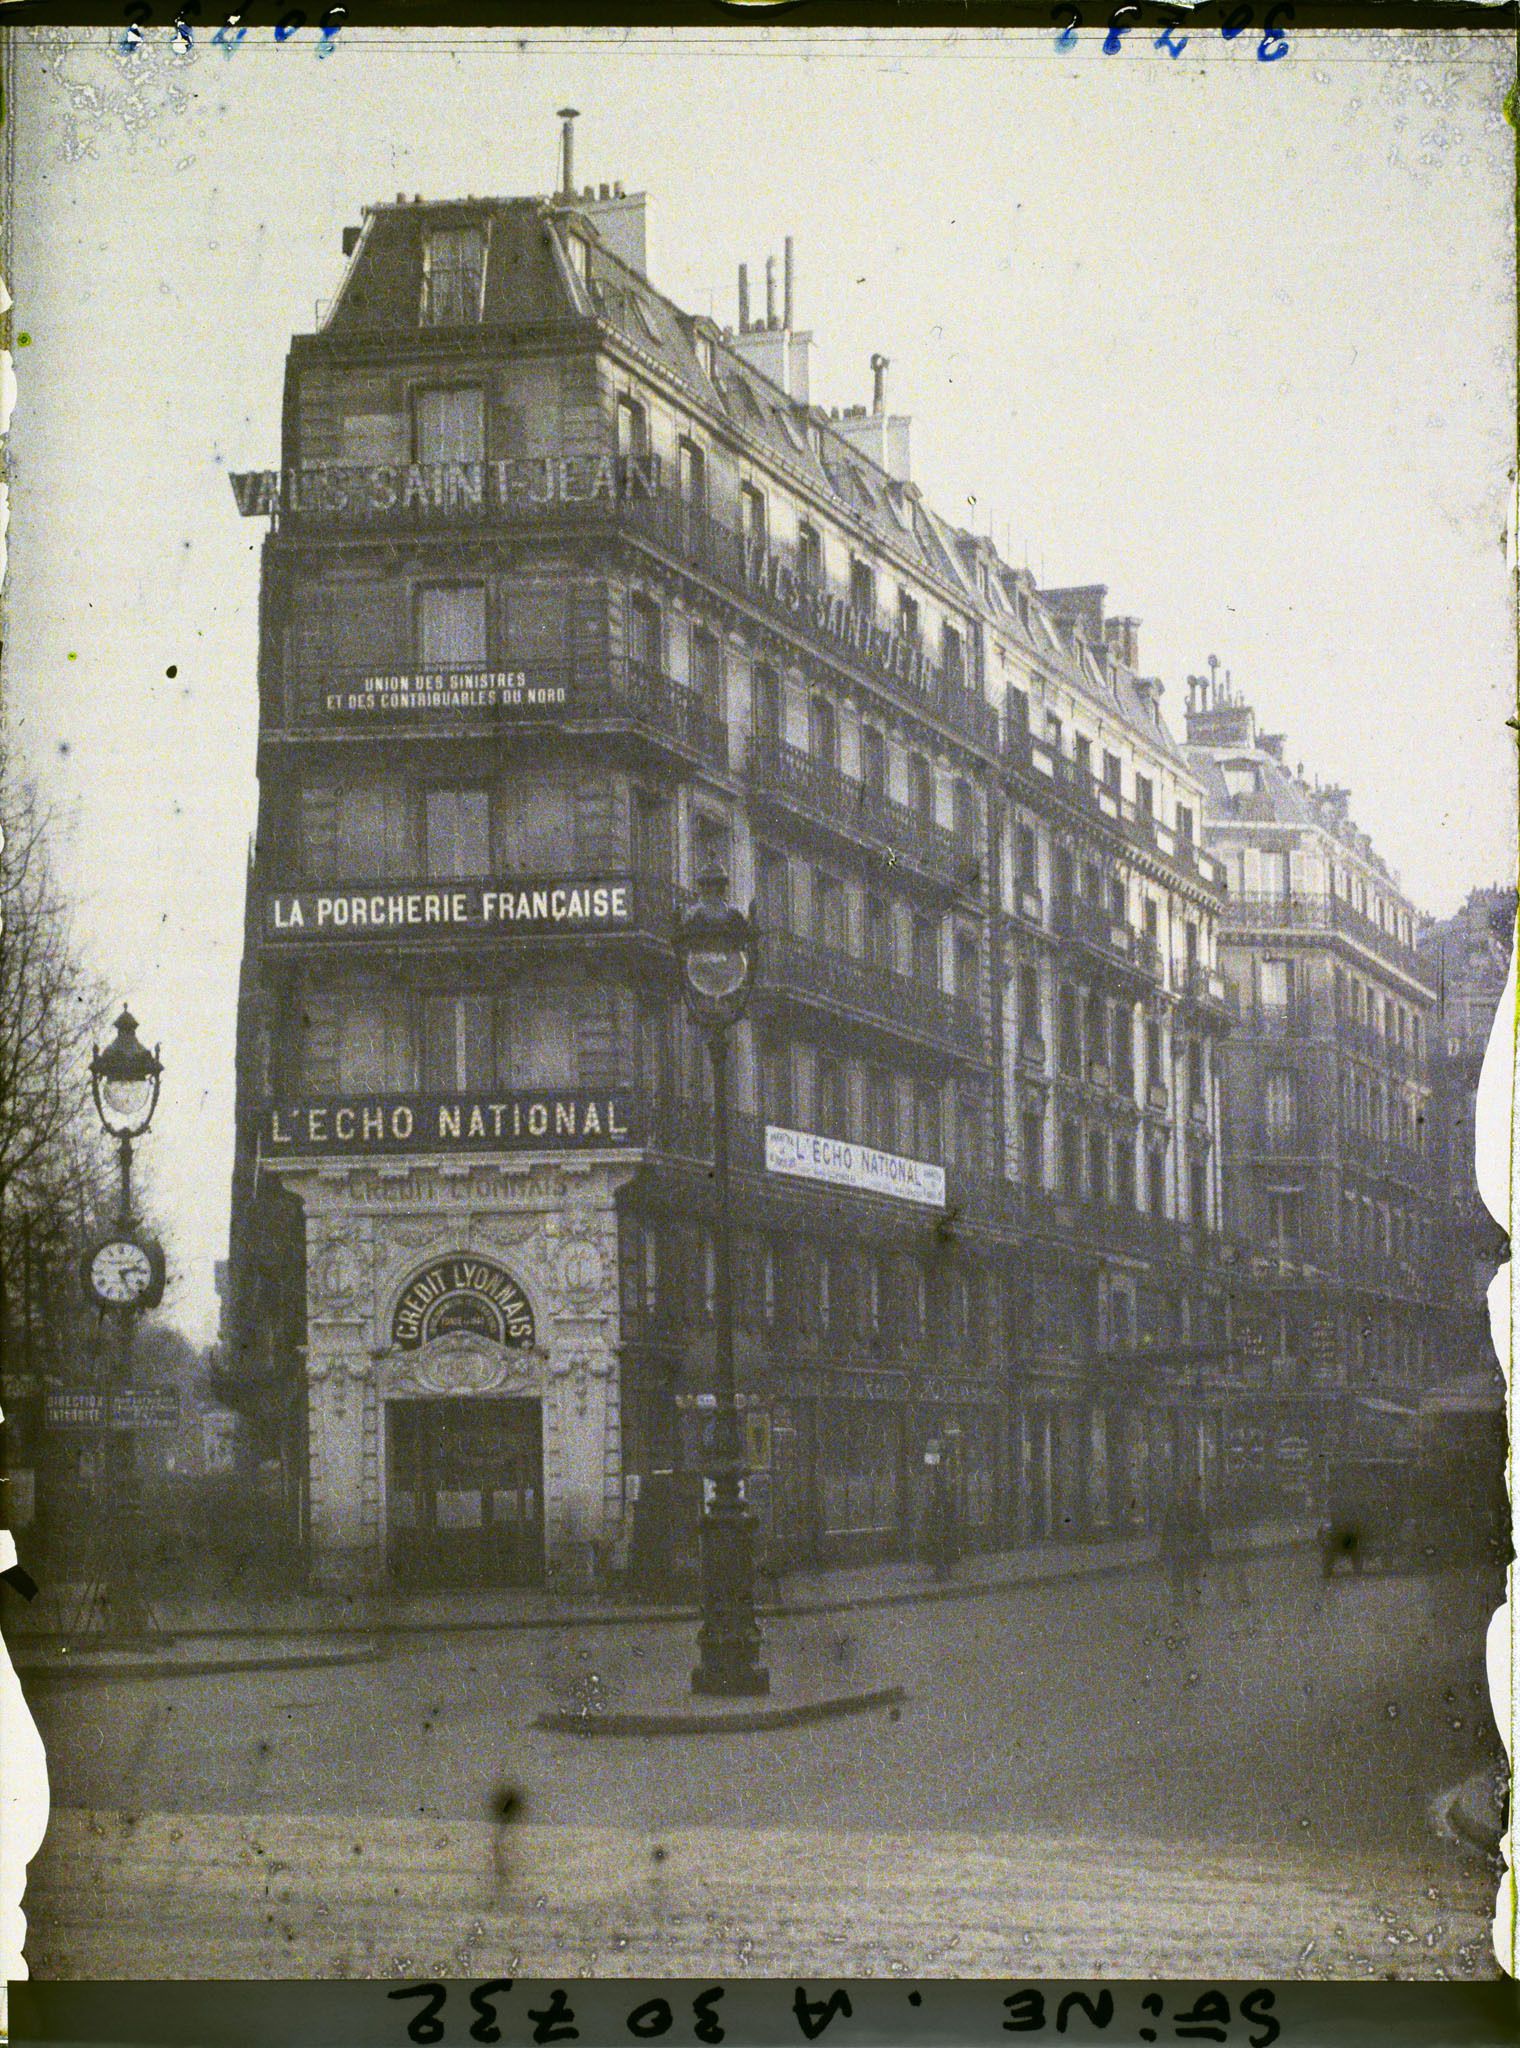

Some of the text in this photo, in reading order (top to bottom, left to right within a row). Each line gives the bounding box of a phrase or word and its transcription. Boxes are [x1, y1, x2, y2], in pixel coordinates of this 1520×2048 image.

[327, 694, 342, 710] ET
[348, 693, 375, 709] DES
[503, 689, 522, 704] DU
[528, 687, 566, 703] NORD
[365, 675, 410, 692] UNION
[415, 674, 444, 691] DES
[274, 887, 629, 929] LA PORCHERIE FRANÇAISE
[271, 1101, 629, 1144] L'ECHO NATIONAL
[796, 1135, 853, 1170] L'ECHO
[861, 1150, 923, 1187] NATIONAL
[396, 1262, 533, 1339] CREDIT LYONNAIS
